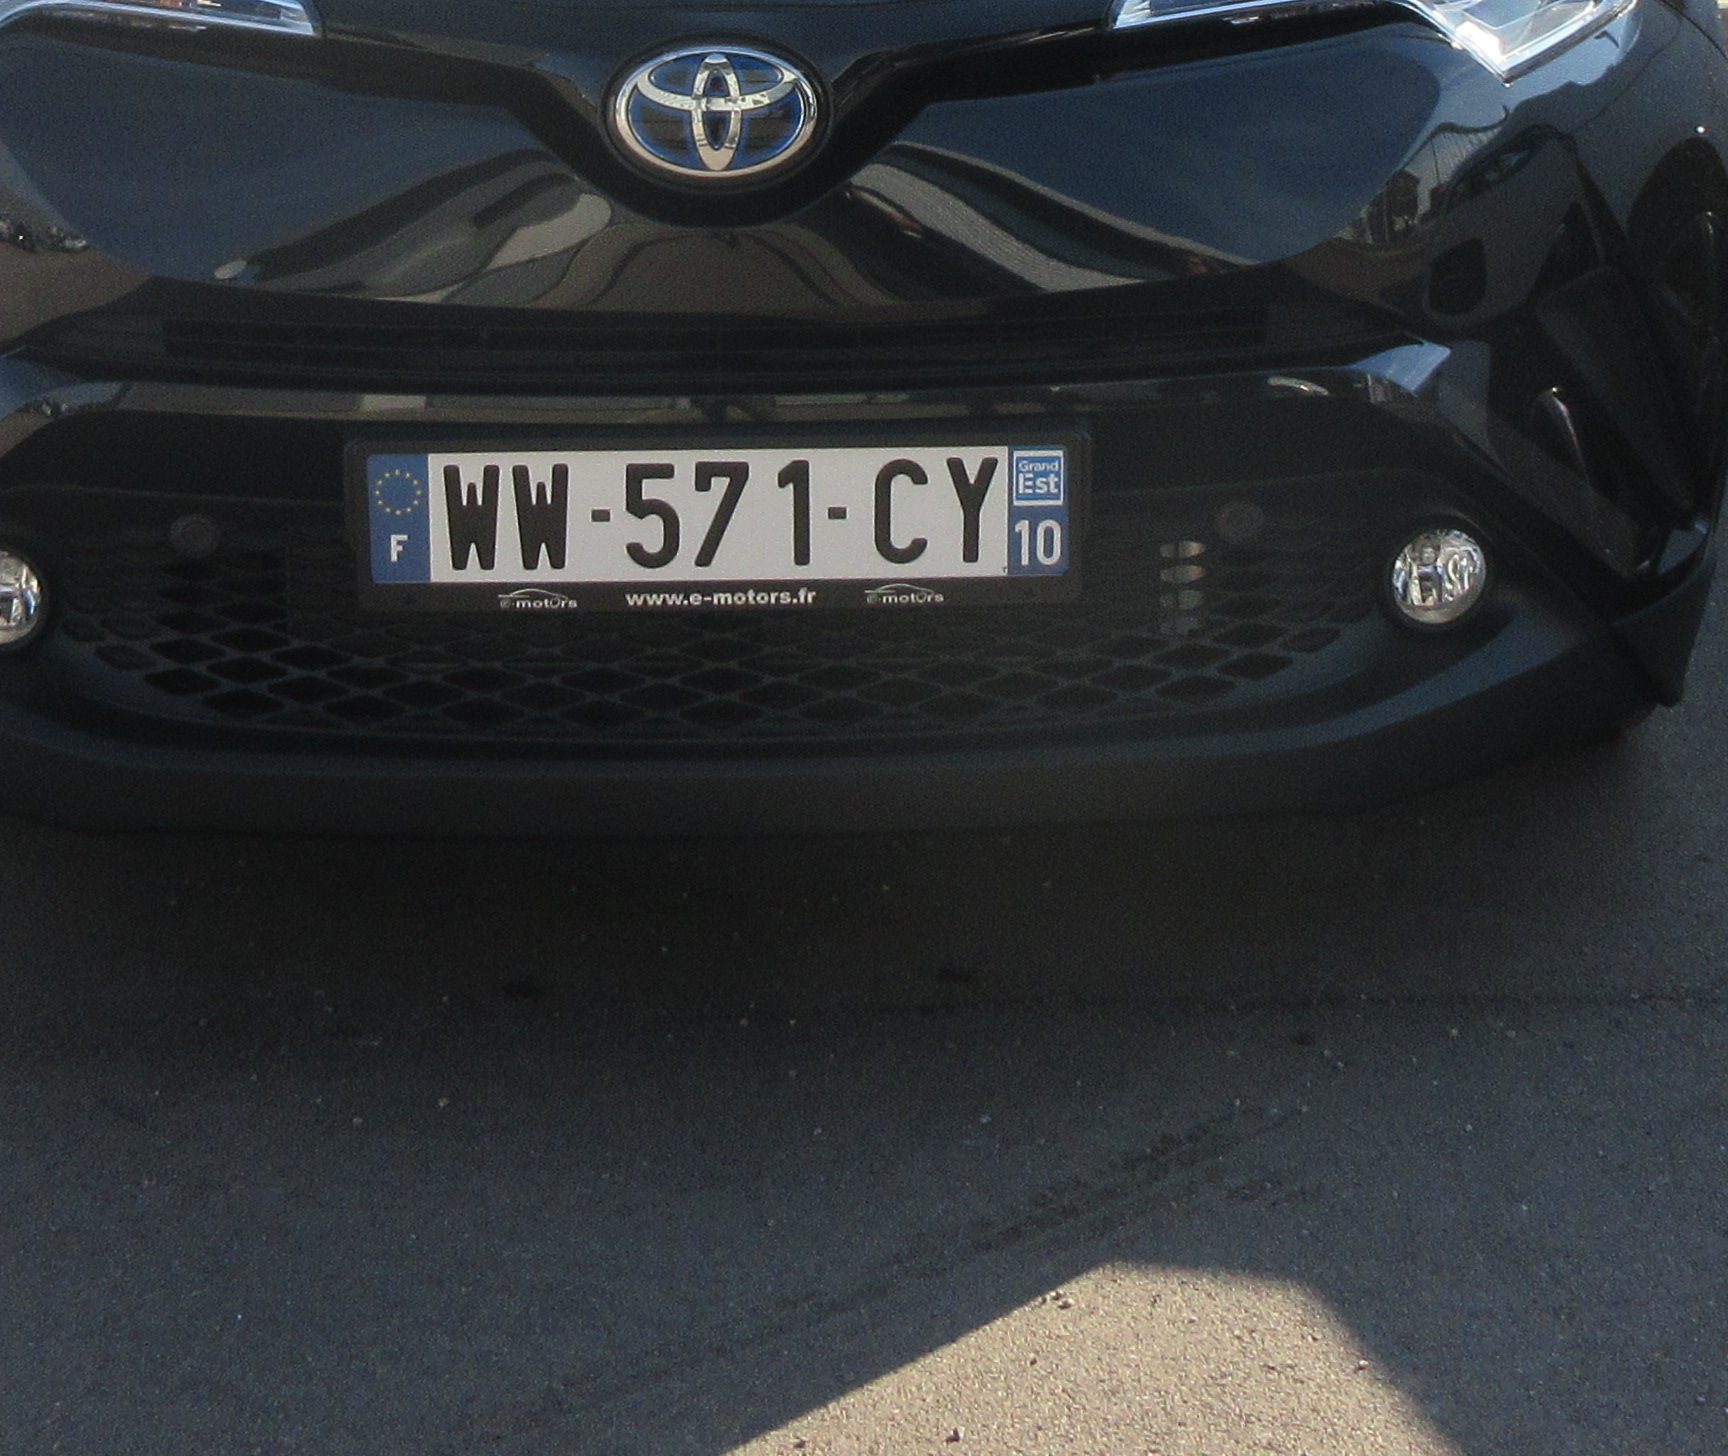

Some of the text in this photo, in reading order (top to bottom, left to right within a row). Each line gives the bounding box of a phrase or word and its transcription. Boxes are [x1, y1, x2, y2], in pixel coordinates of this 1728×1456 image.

[1018, 460, 1059, 472] Grand
[1018, 473, 1059, 494] Est
[443, 457, 999, 570] WW-571-CY
[390, 535, 408, 562] F
[1014, 519, 1062, 566] 10
[626, 587, 817, 606] www.e-motors.fr
